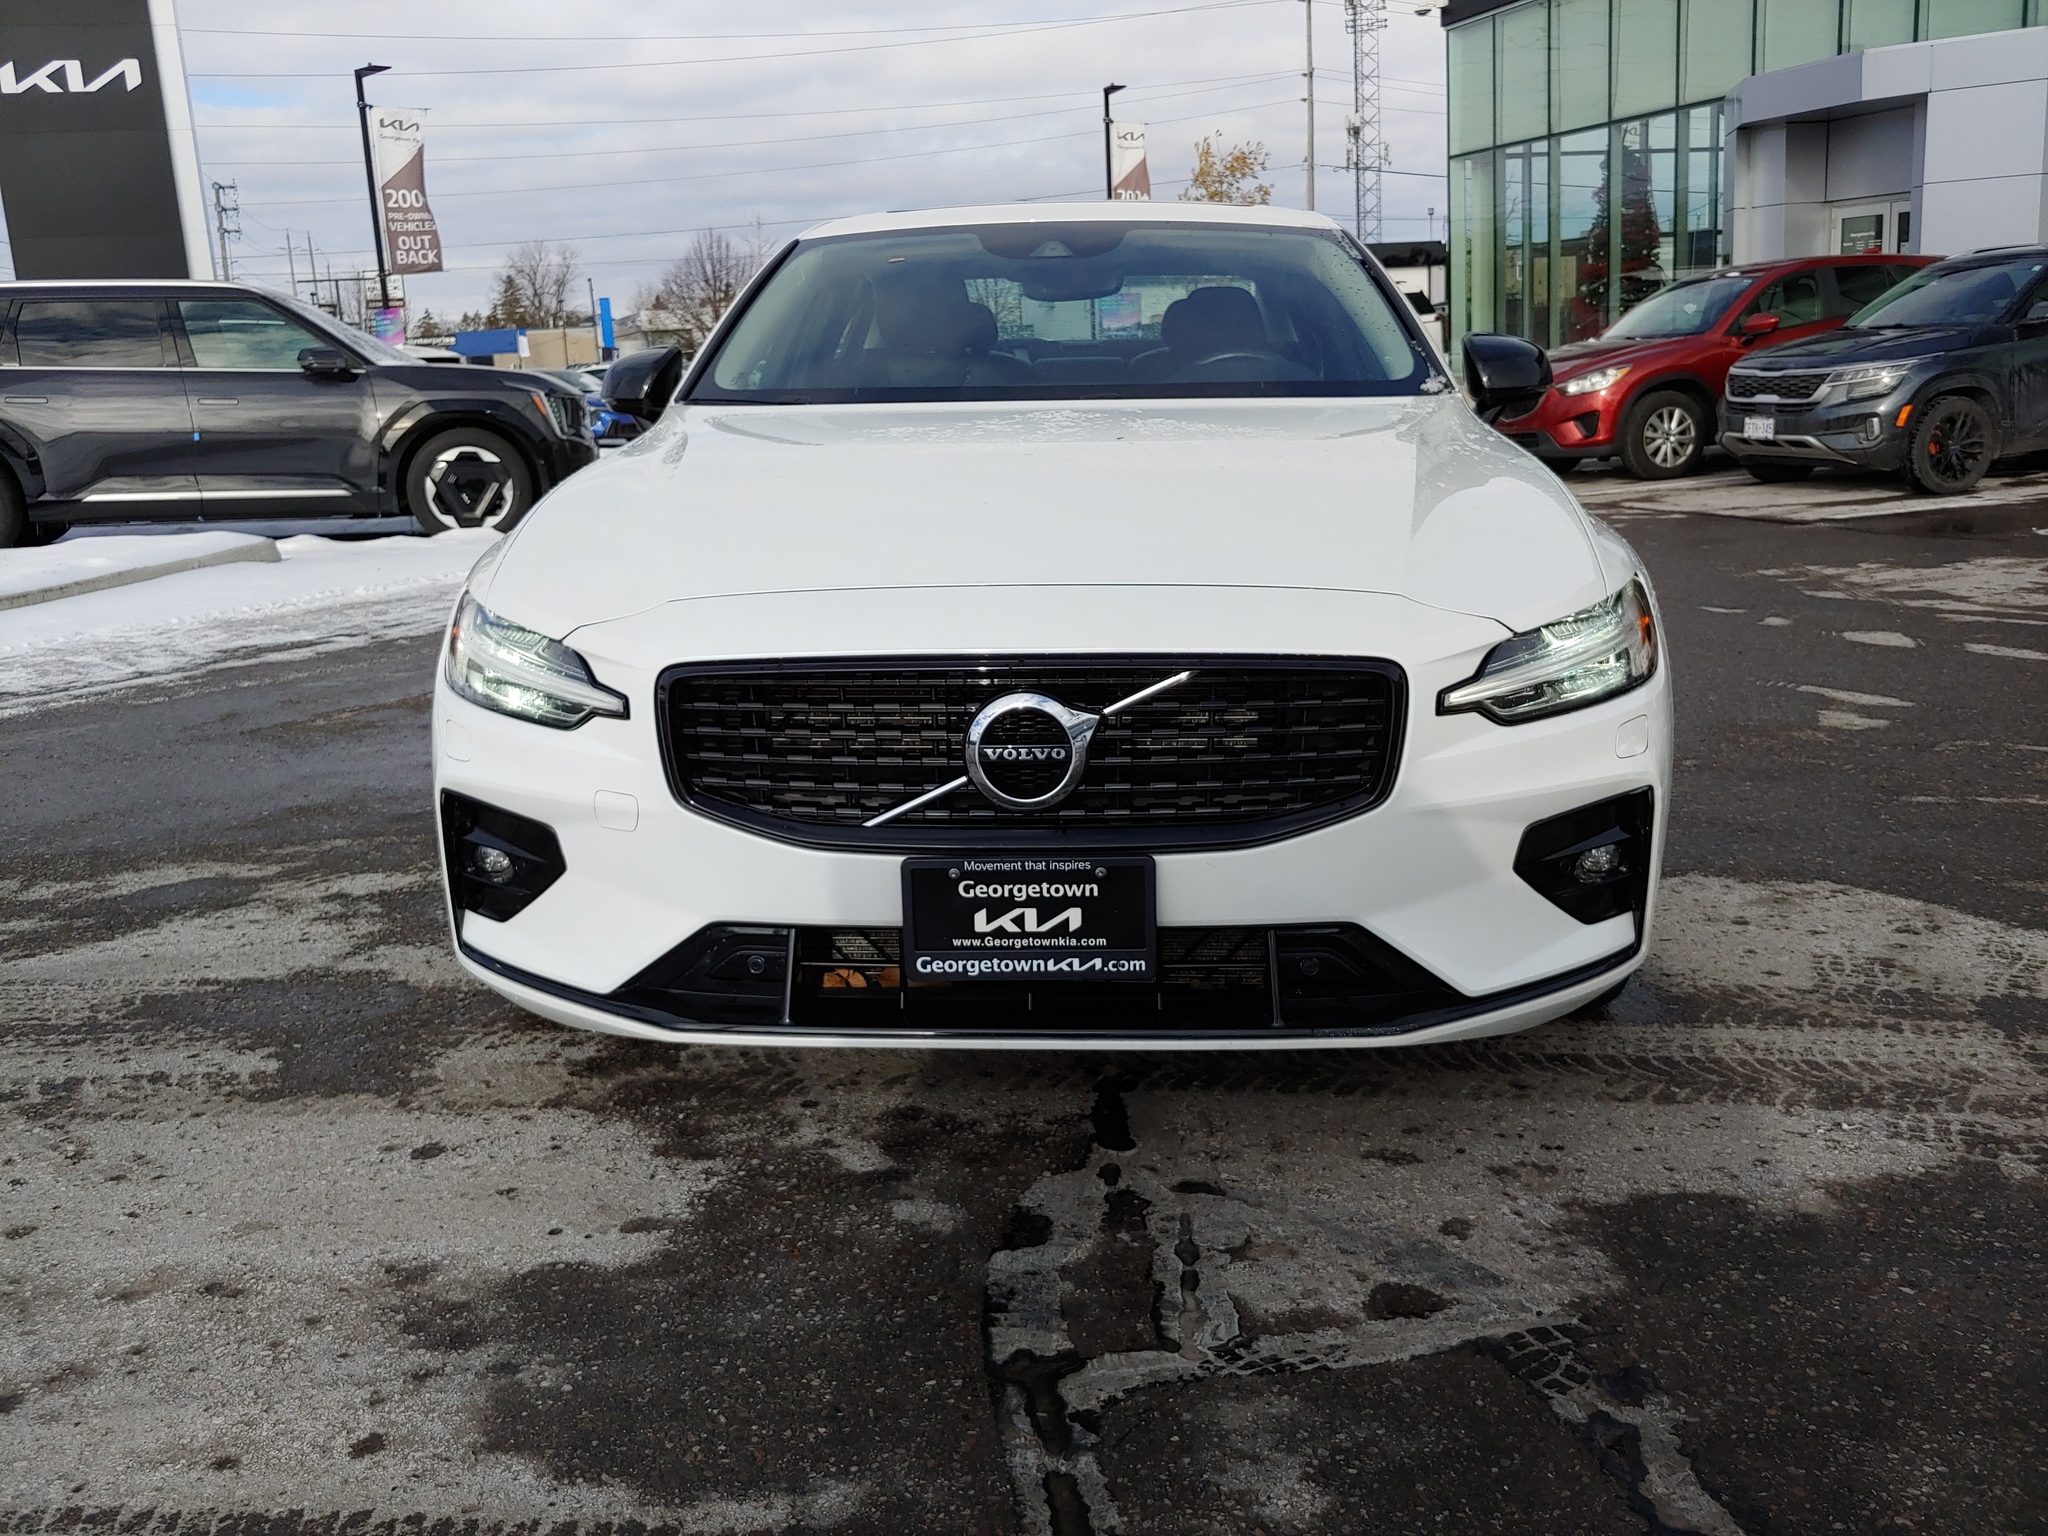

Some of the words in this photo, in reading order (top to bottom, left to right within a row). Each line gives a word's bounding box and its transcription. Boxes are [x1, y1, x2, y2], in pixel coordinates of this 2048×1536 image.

[0, 58, 142, 94] KIA
[379, 117, 420, 132] KIA
[398, 235, 432, 250] OUT
[395, 248, 440, 265] BACK
[983, 748, 1066, 760] VOLVO
[964, 861, 1022, 871] Movement
[1024, 861, 1047, 871] that
[1049, 861, 1091, 873] inspires
[958, 880, 1099, 902] Georgetown
[974, 907, 1082, 933] KIA
[952, 936, 1107, 949] www.Georgetownkia.com
